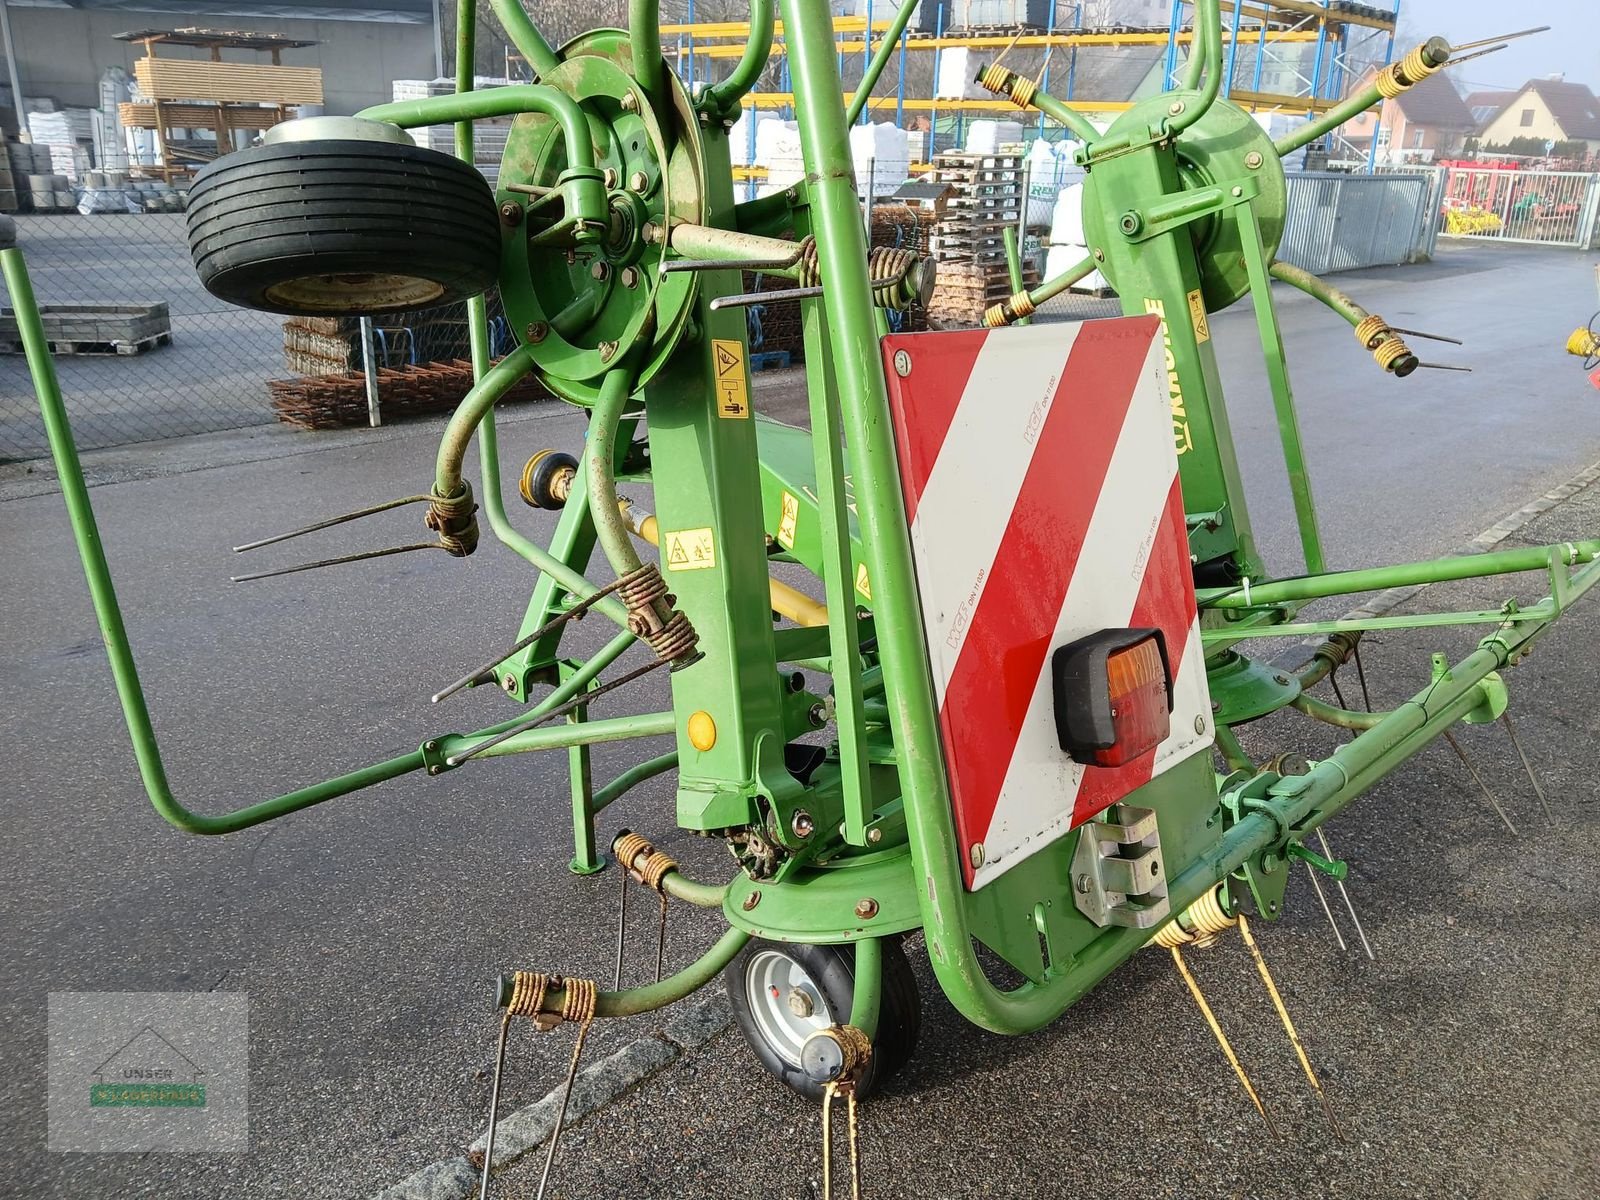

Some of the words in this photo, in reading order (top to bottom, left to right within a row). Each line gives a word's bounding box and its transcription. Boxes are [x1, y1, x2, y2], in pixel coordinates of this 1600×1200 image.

[1041, 394, 1049, 408] DIN
[968, 591, 977, 606] DIN
[977, 568, 985, 583] 030
